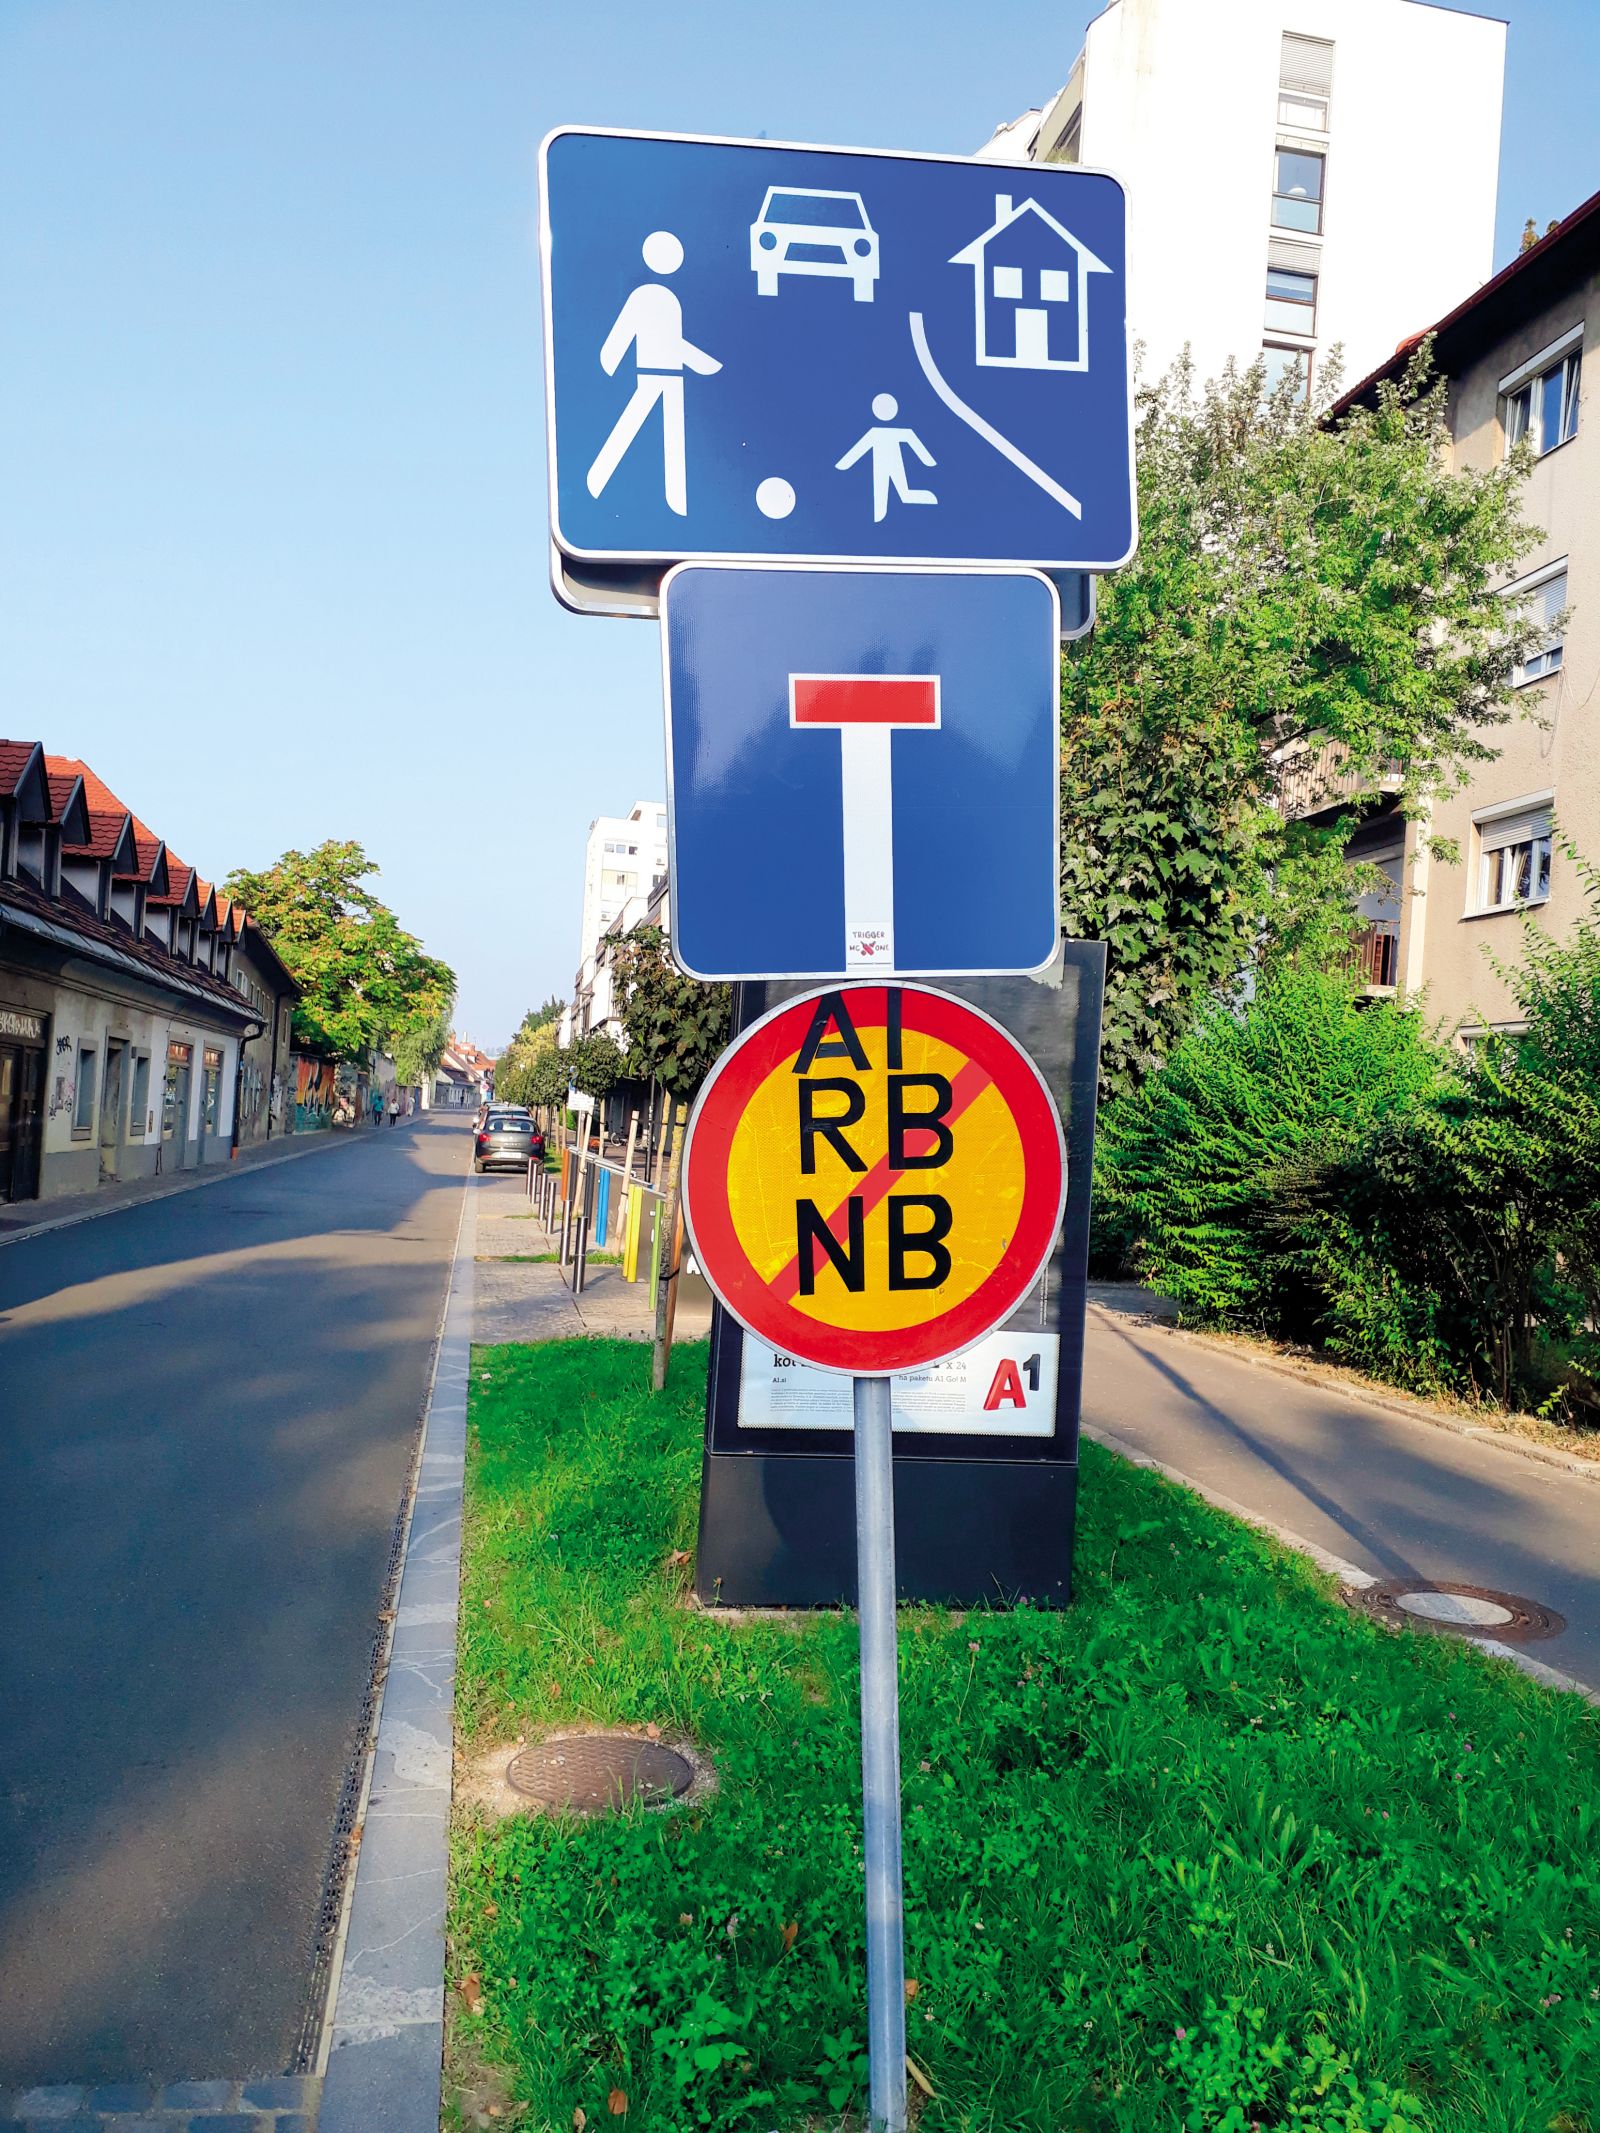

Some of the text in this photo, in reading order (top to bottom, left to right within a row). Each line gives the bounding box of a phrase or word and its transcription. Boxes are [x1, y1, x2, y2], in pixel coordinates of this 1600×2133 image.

[852, 931, 885, 939] TRIGGER
[909, 1374, 933, 1382] paketu
[983, 1353, 1041, 1411] A1
